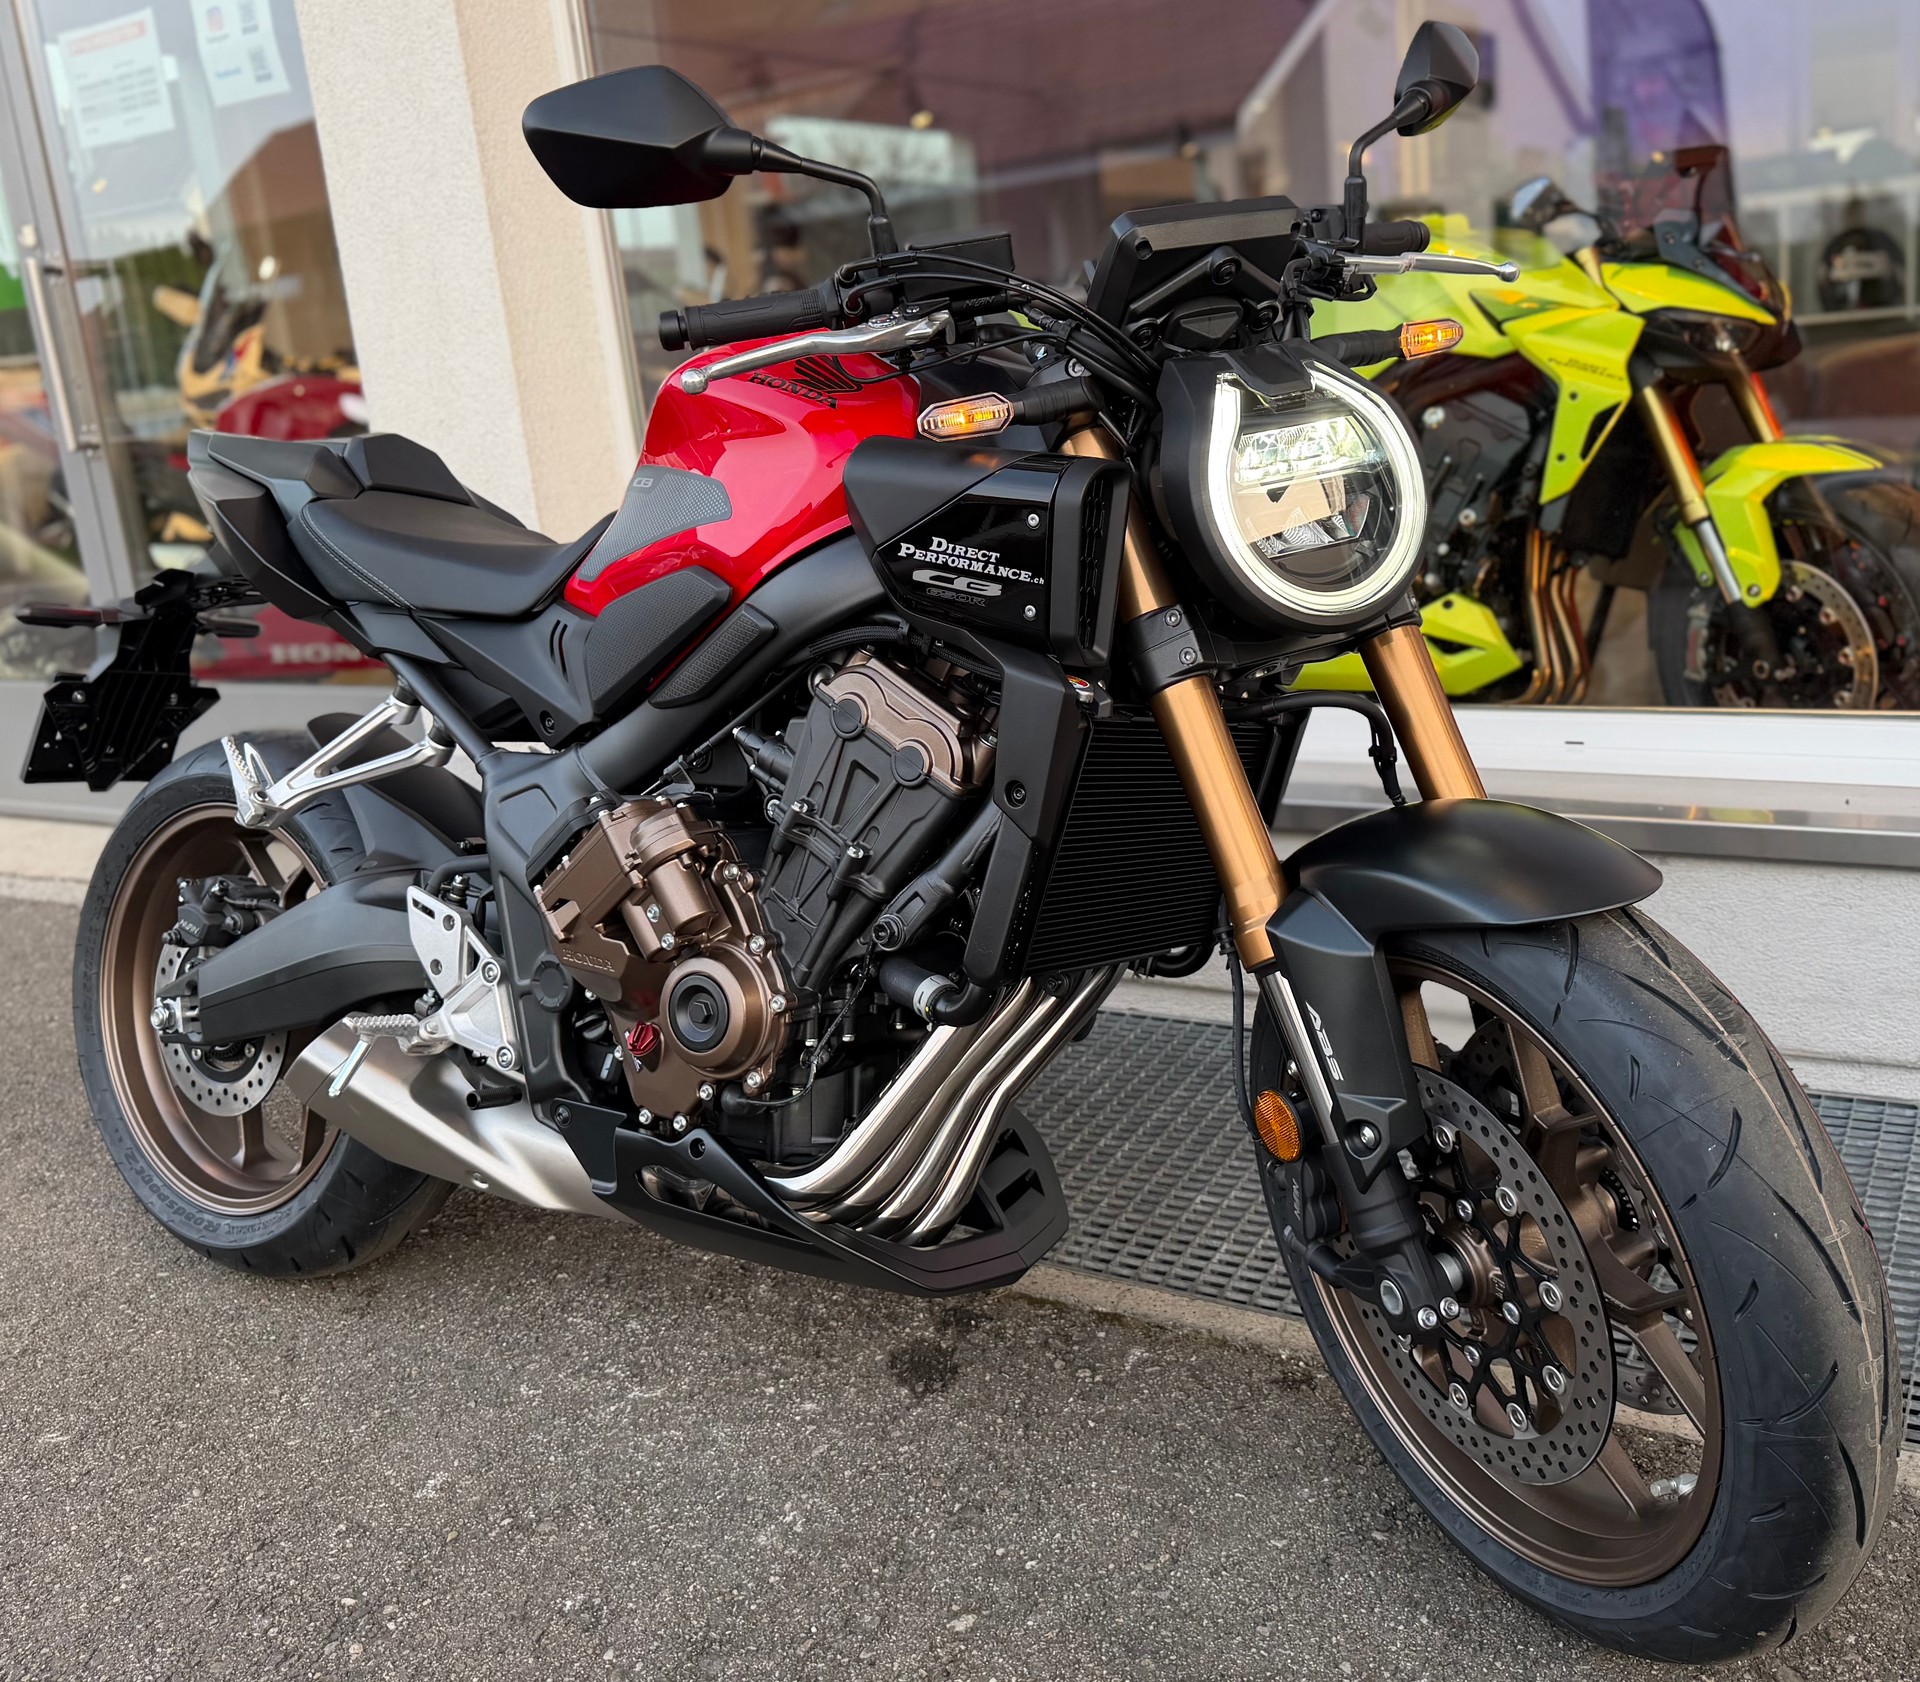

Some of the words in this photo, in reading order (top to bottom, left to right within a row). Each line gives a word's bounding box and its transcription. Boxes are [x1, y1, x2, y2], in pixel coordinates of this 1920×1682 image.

[748, 371, 837, 410] HONDA
[897, 543, 1045, 585] PERFORMANCE.ch
[929, 536, 1000, 563] DIRECT
[912, 569, 1002, 596] CB
[562, 949, 616, 973] HONDA
[1305, 1001, 1345, 1081] ABS
